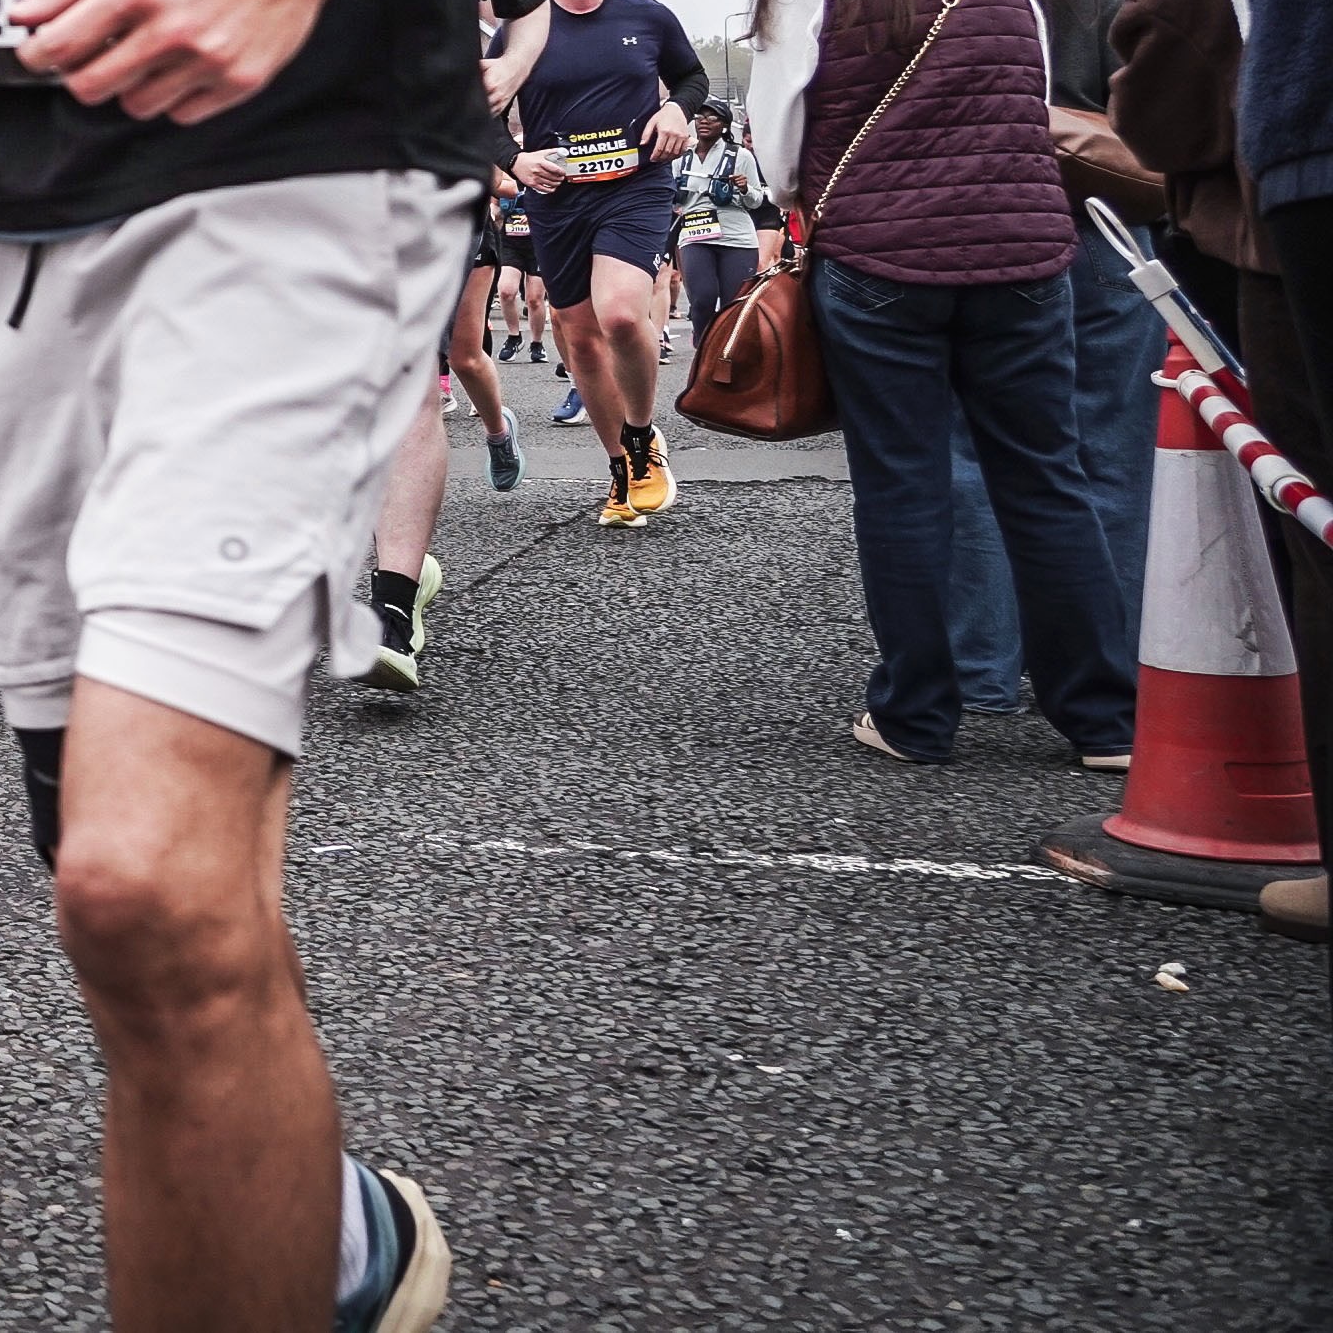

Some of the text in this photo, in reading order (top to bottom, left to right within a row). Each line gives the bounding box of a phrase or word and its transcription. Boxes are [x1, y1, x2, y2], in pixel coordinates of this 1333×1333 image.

[577, 127, 623, 142] MCR HALF
[569, 138, 628, 156] CHARLIE
[578, 157, 625, 174] 22170
[688, 227, 712, 236] 19879
